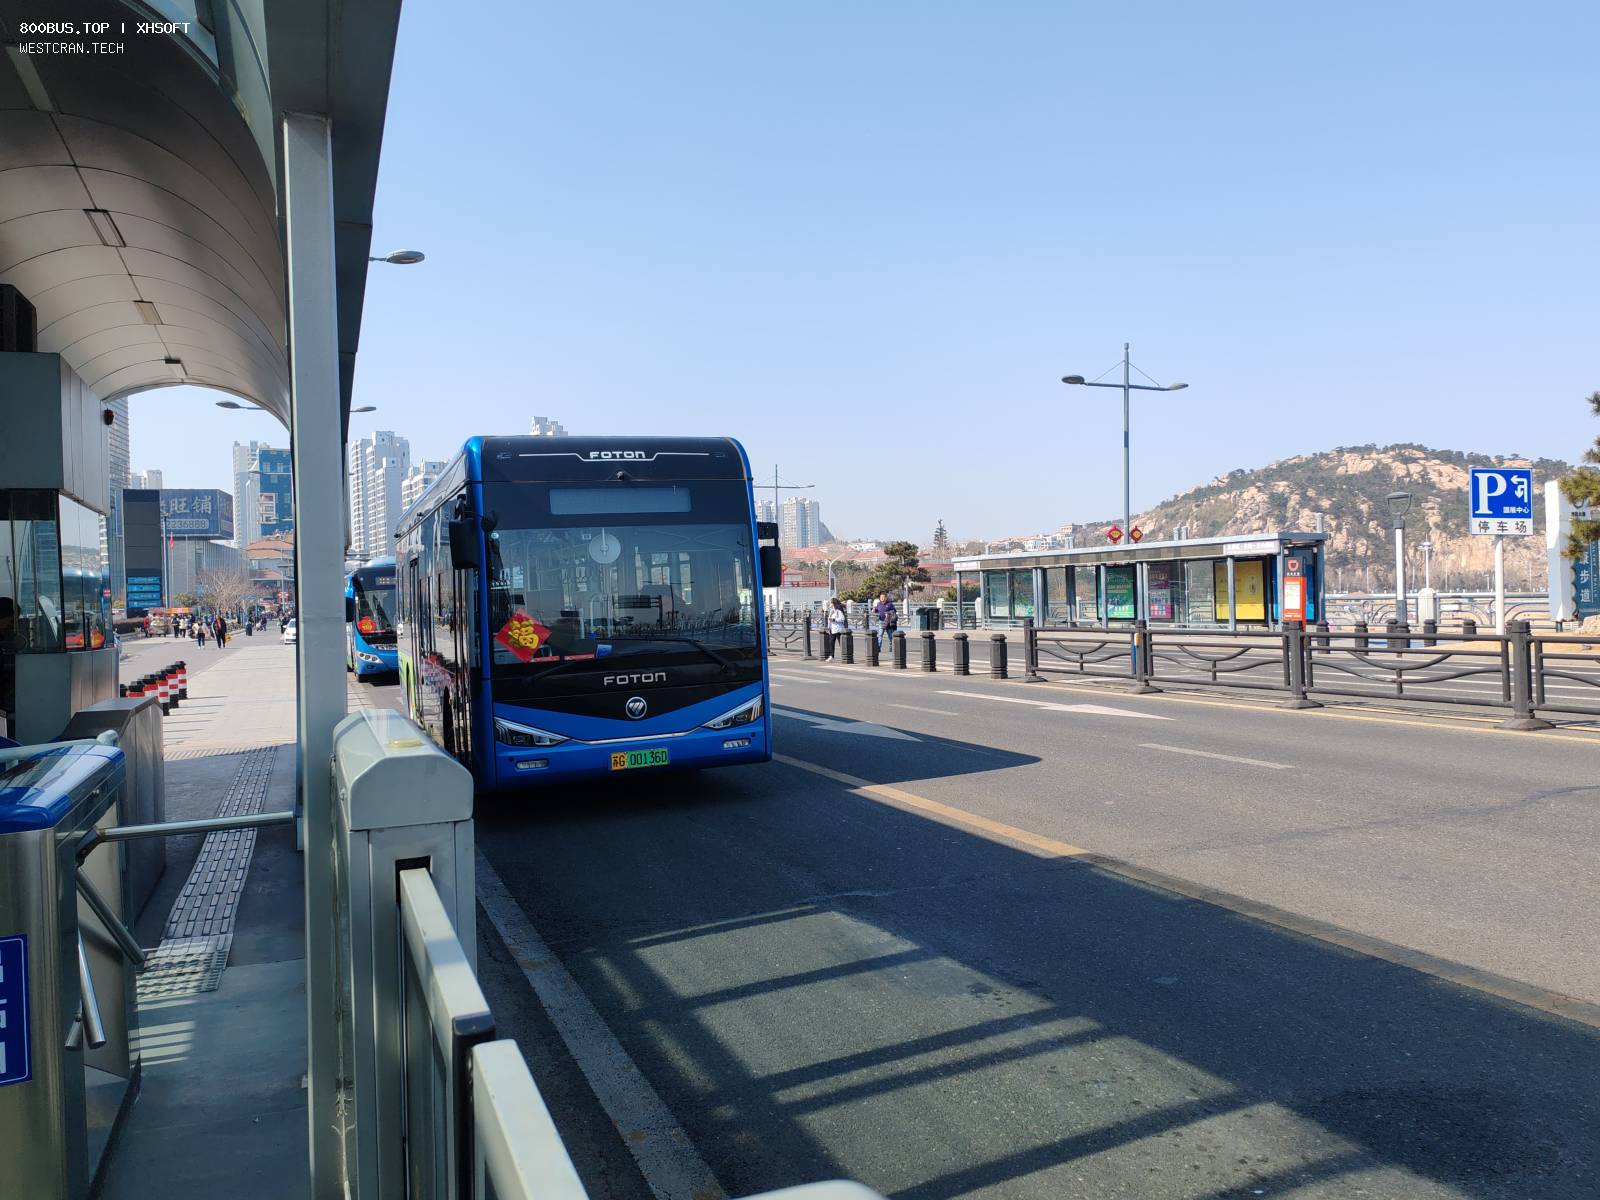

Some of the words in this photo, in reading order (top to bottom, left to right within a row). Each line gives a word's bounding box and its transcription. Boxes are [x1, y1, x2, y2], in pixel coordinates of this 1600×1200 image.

[589, 451, 646, 459] FOTON
[1474, 472, 1507, 514] P
[1478, 520, 1528, 533] 停车场
[603, 672, 667, 686] FOTON
